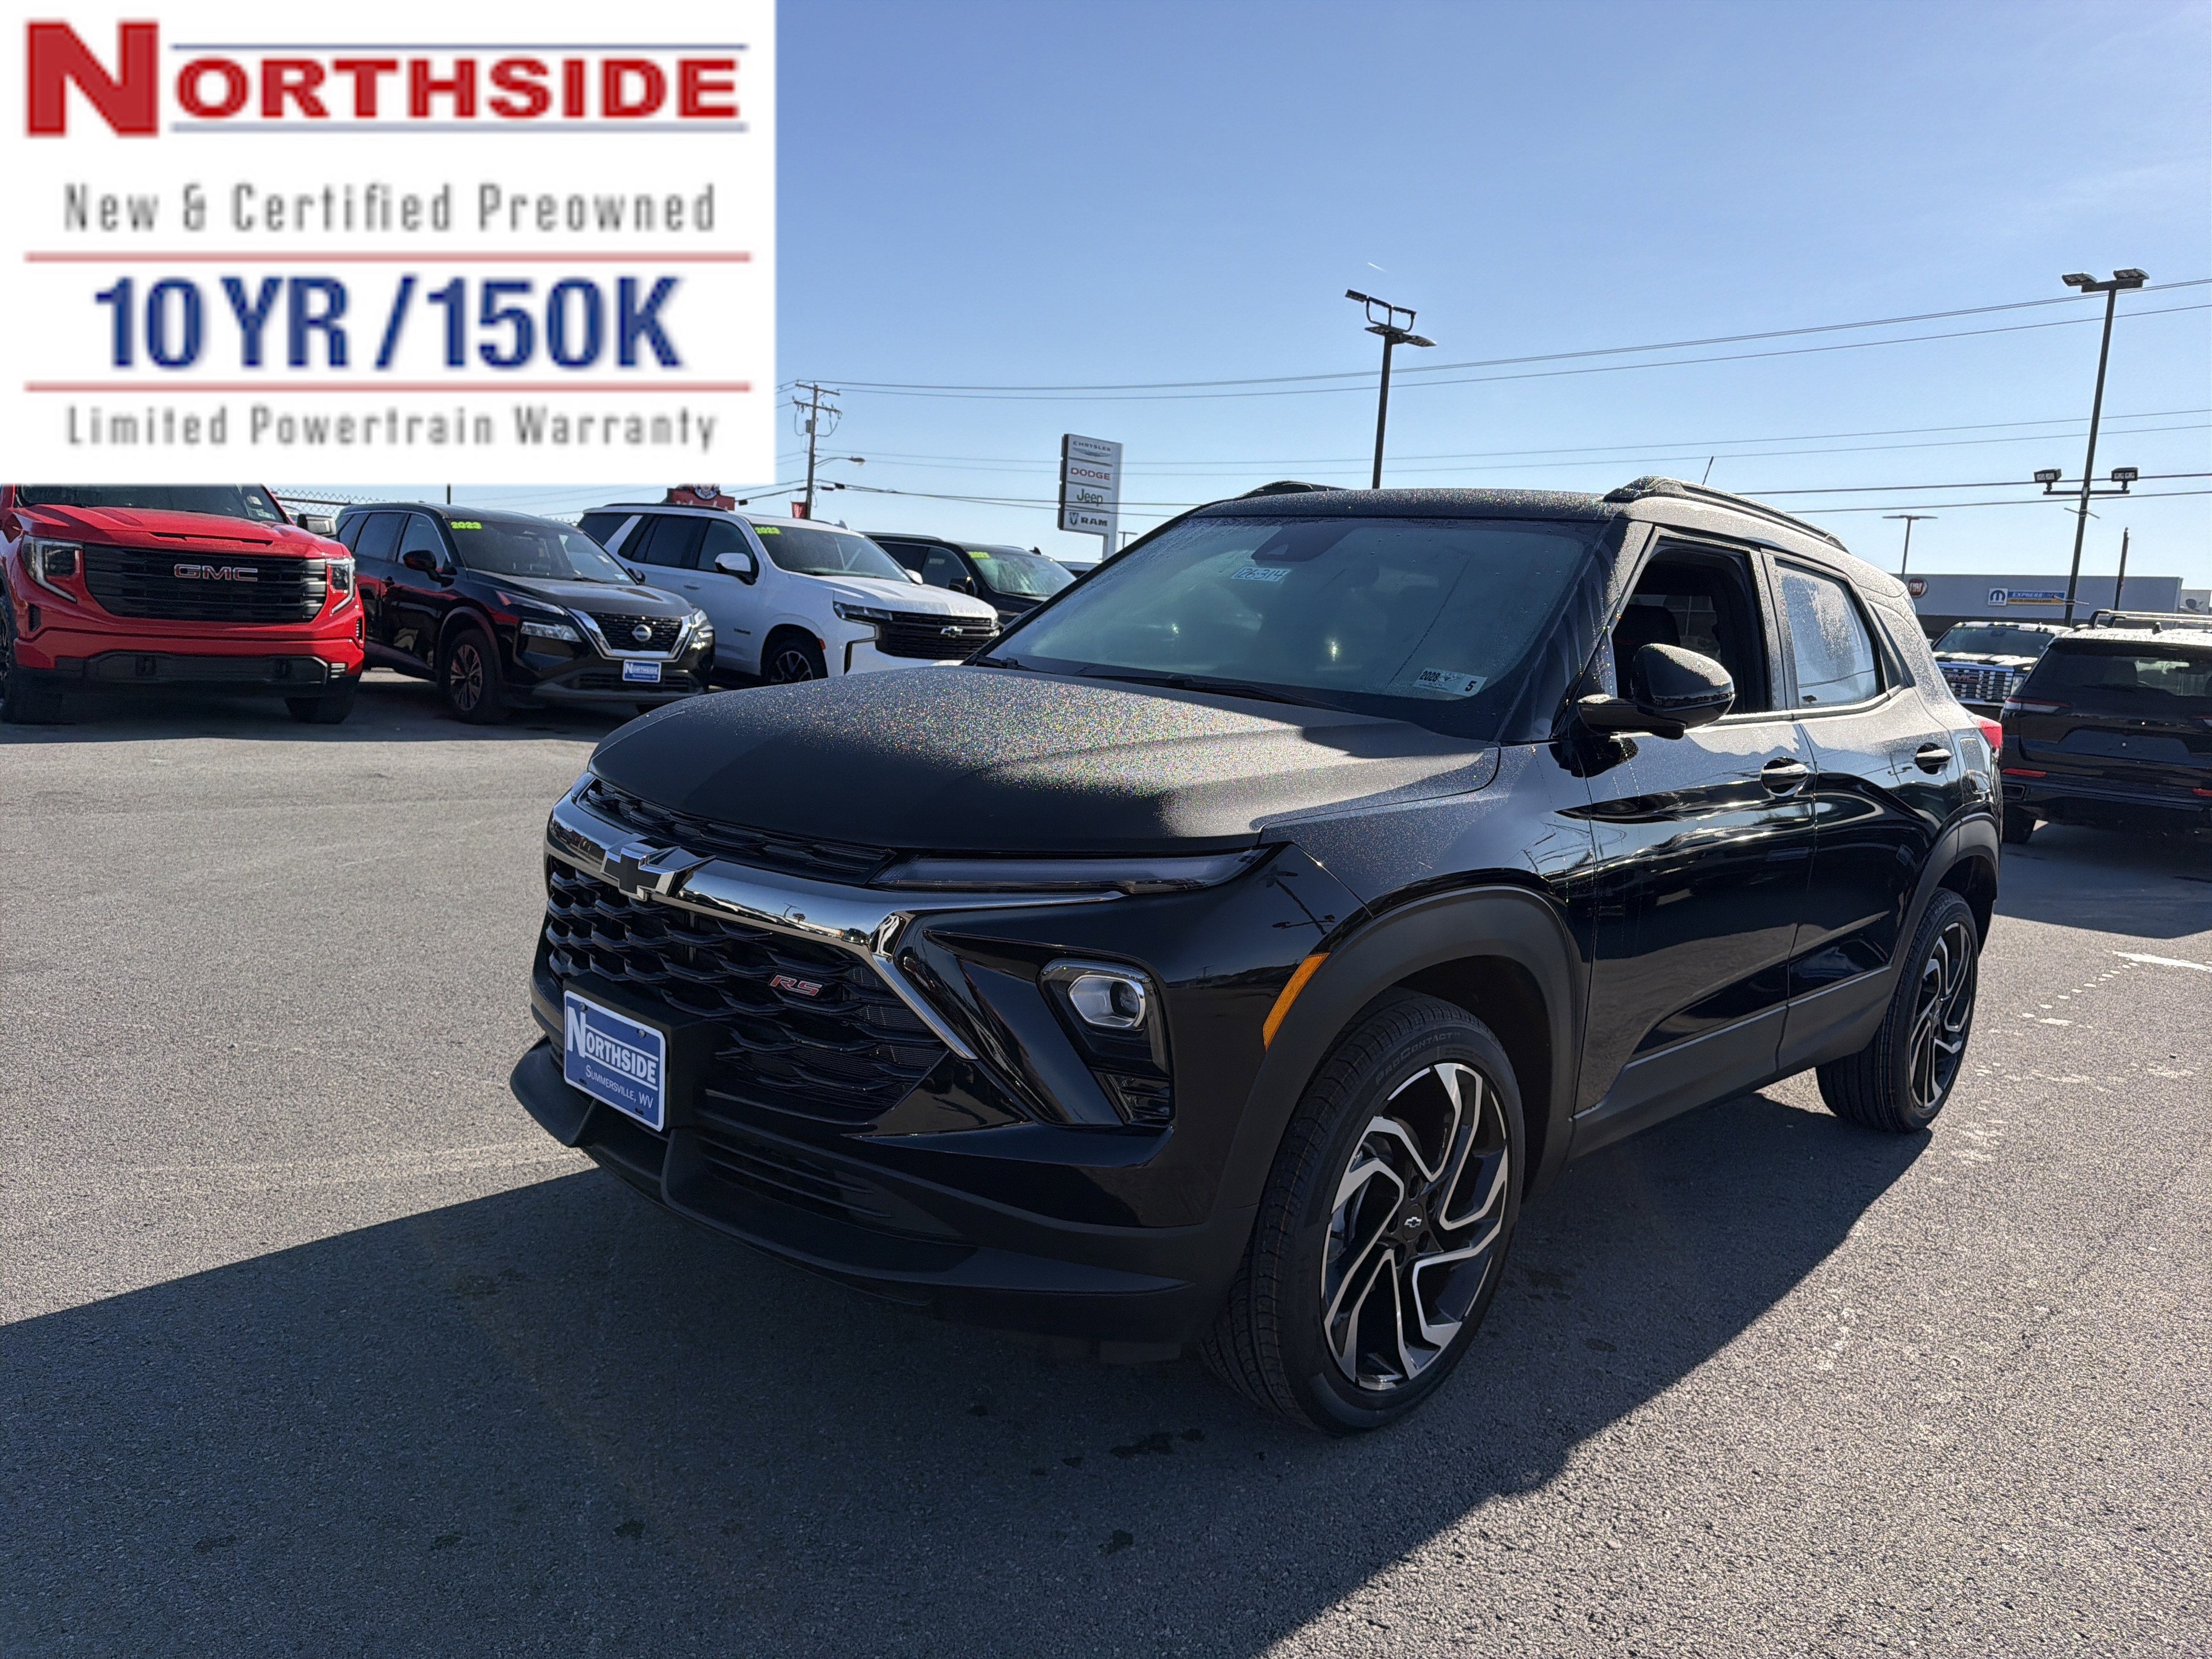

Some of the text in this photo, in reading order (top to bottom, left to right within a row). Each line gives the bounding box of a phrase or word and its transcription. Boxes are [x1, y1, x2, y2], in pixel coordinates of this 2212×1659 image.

[1073, 441, 1111, 452] CHRYSLER
[1070, 467, 1110, 481] DODGE
[1076, 488, 1103, 507] Jeep
[1081, 516, 1108, 527] RAM
[174, 564, 258, 582] GMC
[1419, 670, 1477, 692] 2028 5
[770, 975, 822, 996] RS
[567, 1006, 657, 1085] NORTHSIDE
[585, 1064, 654, 1109] SUMMERSVILLE, WV
